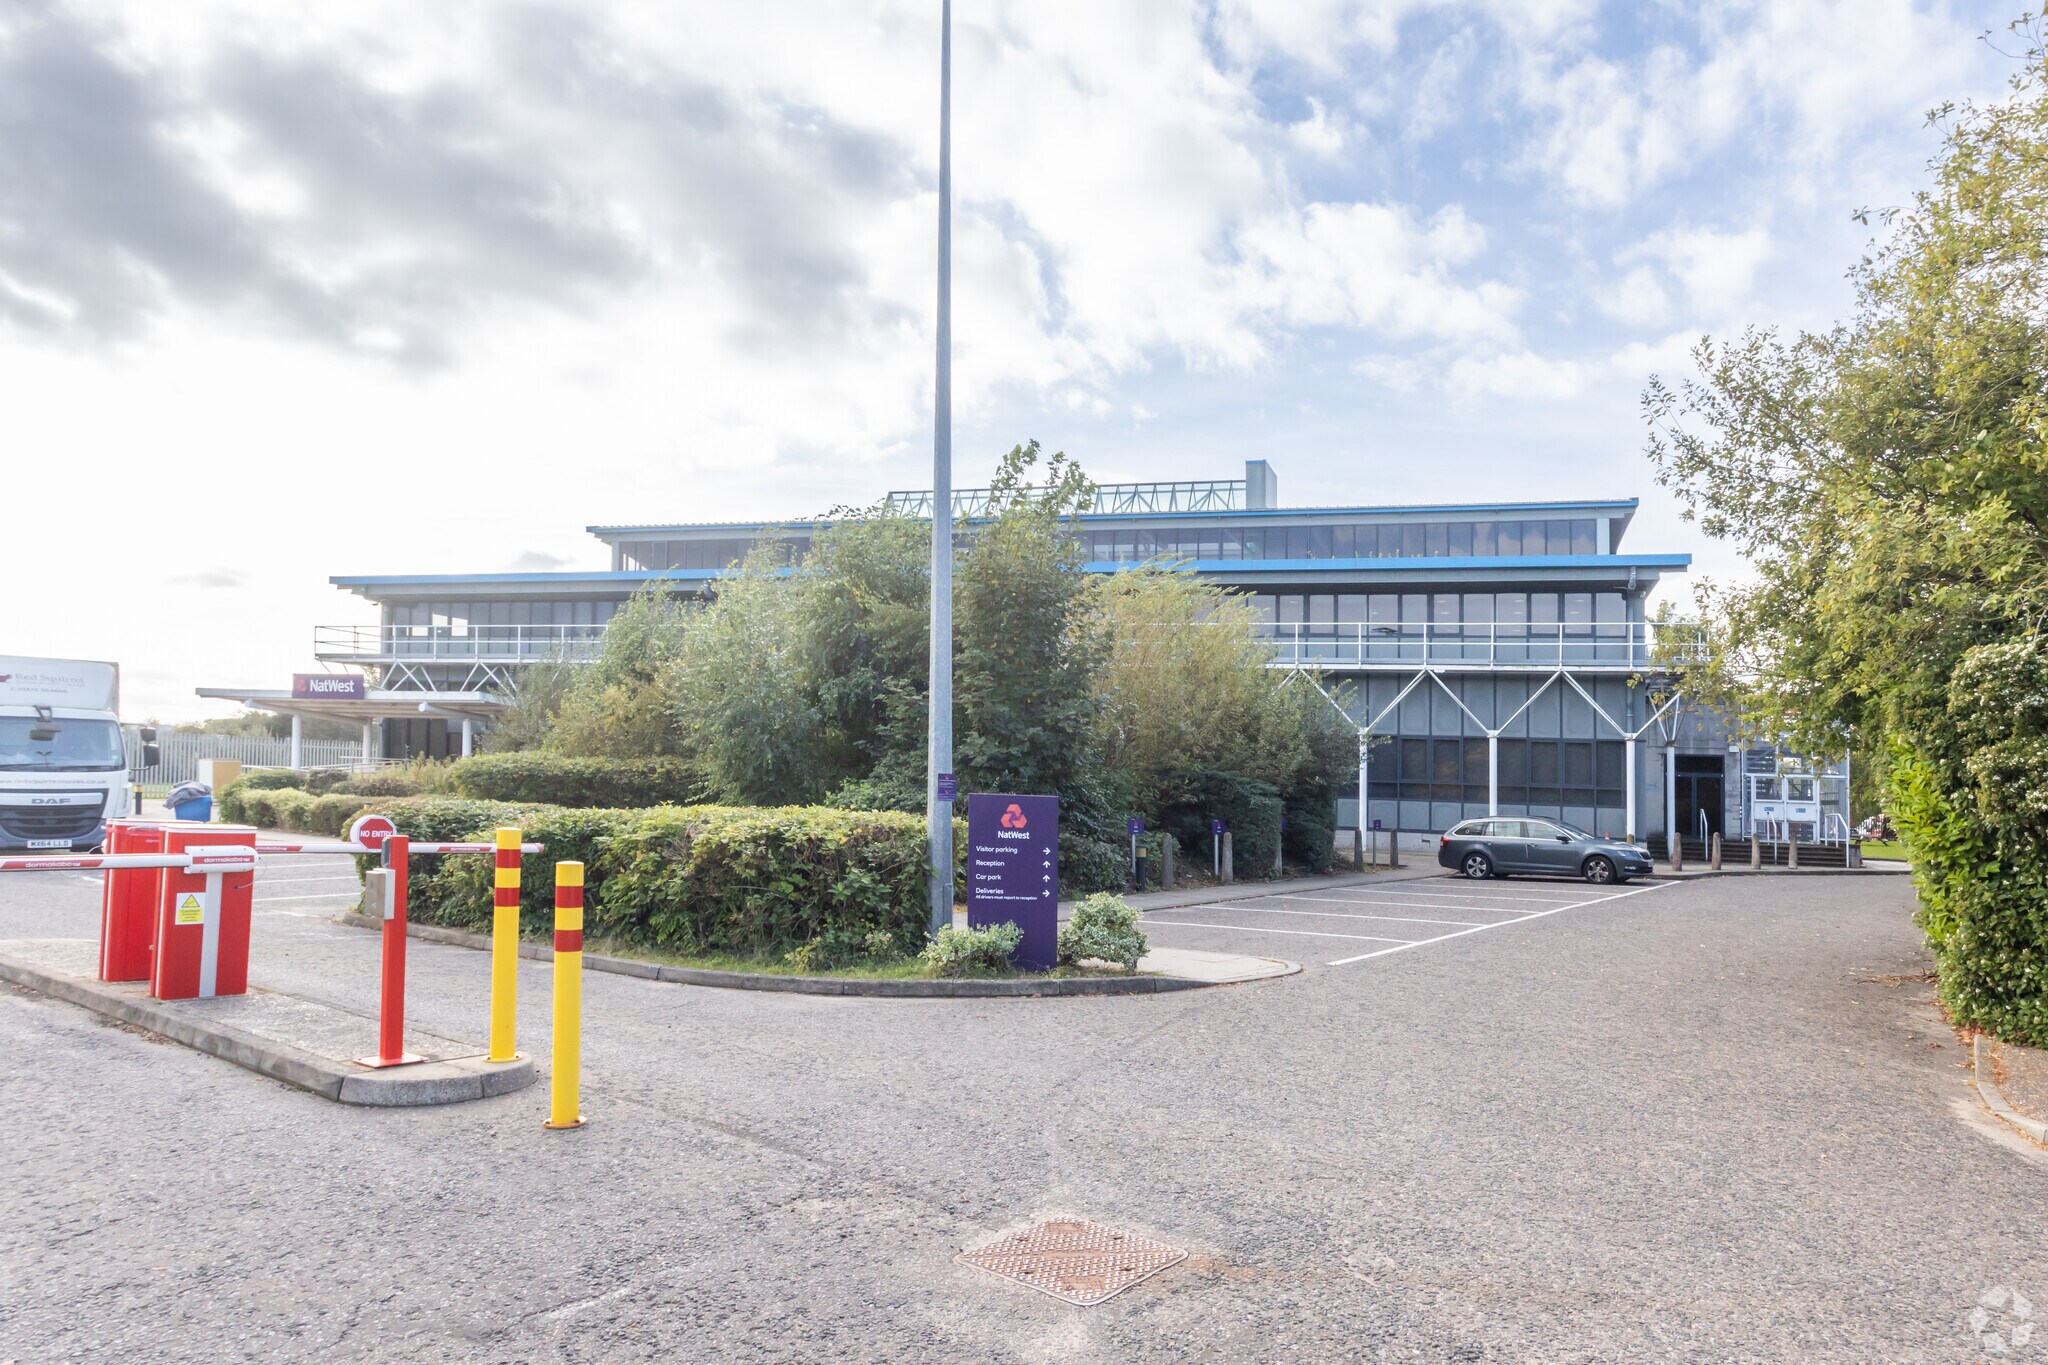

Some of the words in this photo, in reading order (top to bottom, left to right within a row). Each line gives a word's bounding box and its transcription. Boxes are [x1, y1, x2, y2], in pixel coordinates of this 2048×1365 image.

[40, 674, 84, 683] Squirrel
[309, 680, 354, 692] NatWest
[997, 830, 1030, 839] NatWest
